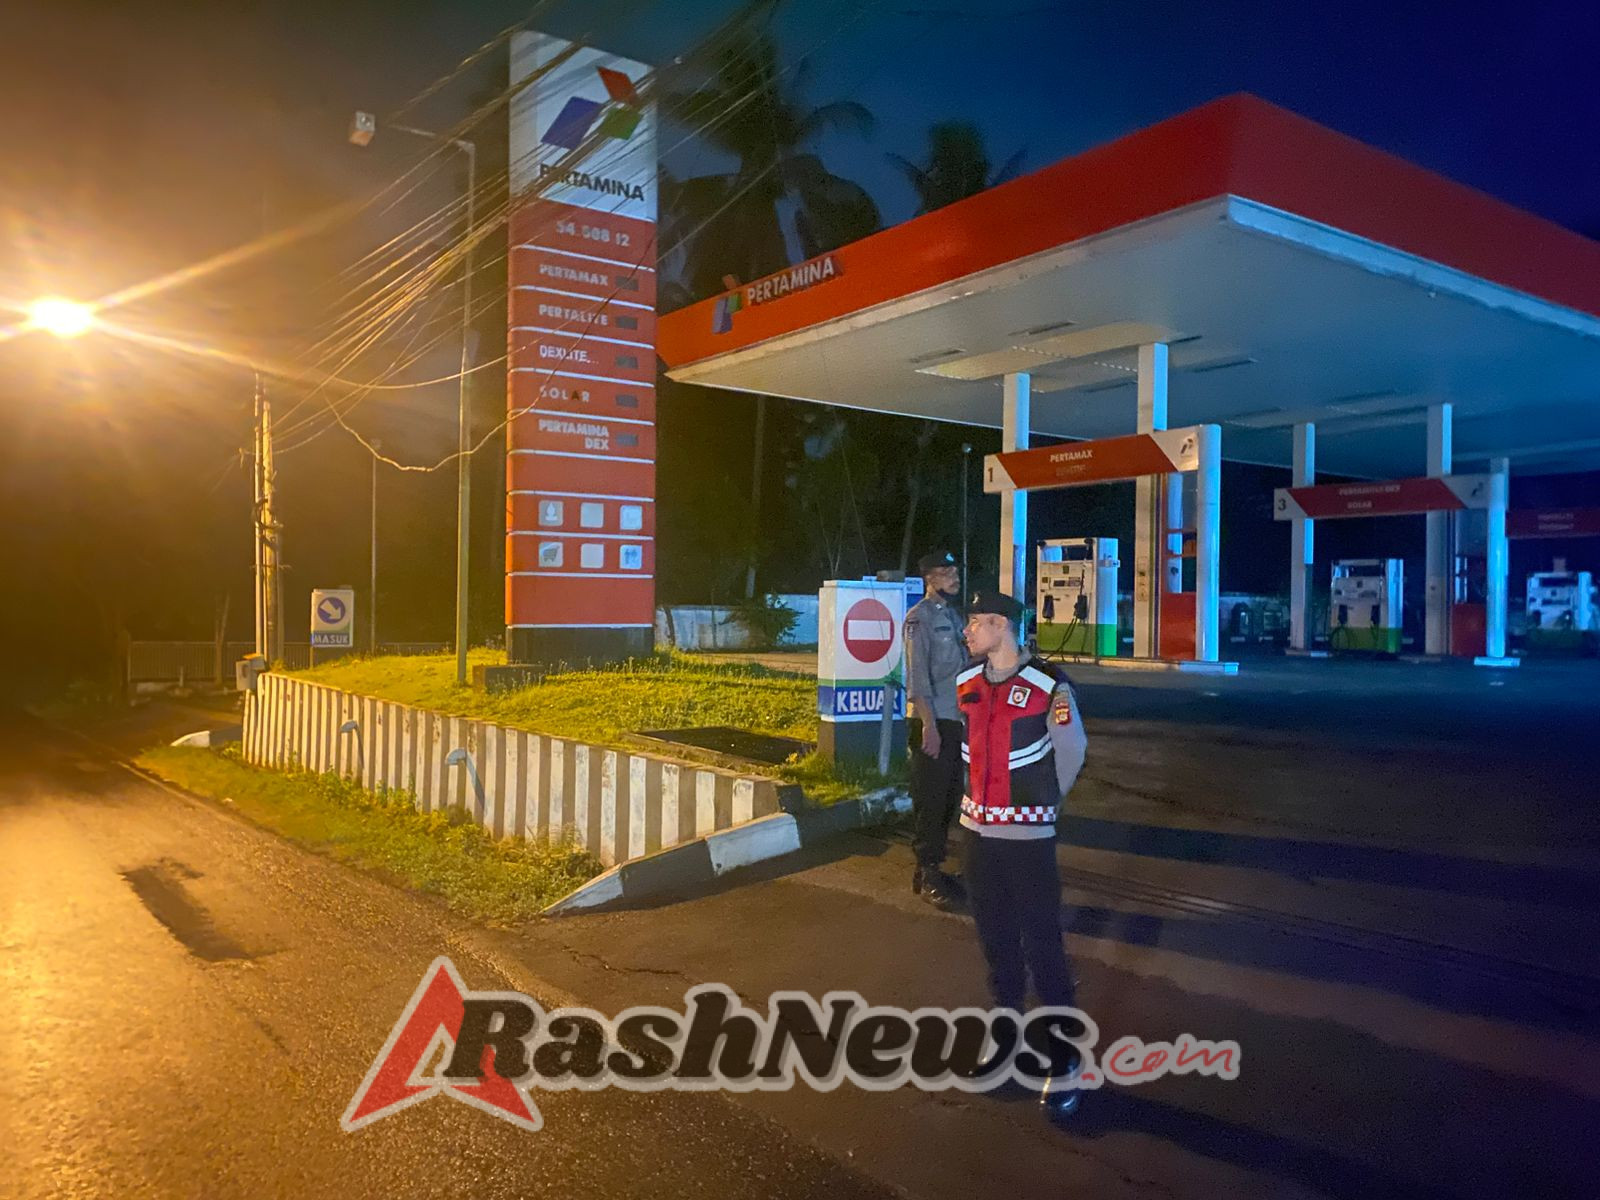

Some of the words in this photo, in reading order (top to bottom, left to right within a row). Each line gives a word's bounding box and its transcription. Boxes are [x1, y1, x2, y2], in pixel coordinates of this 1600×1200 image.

[540, 163, 644, 202] PTAMINA
[540, 264, 608, 286] PERTAMAX
[747, 256, 835, 306] PERTAMINA
[540, 385, 590, 402] SOLAR
[539, 419, 609, 437] PERTAMINA
[584, 437, 609, 450] DEX
[1050, 449, 1093, 463] PERTAMAX
[987, 467, 994, 482] 1
[1277, 498, 1287, 511] 3
[313, 633, 348, 644] MASUK
